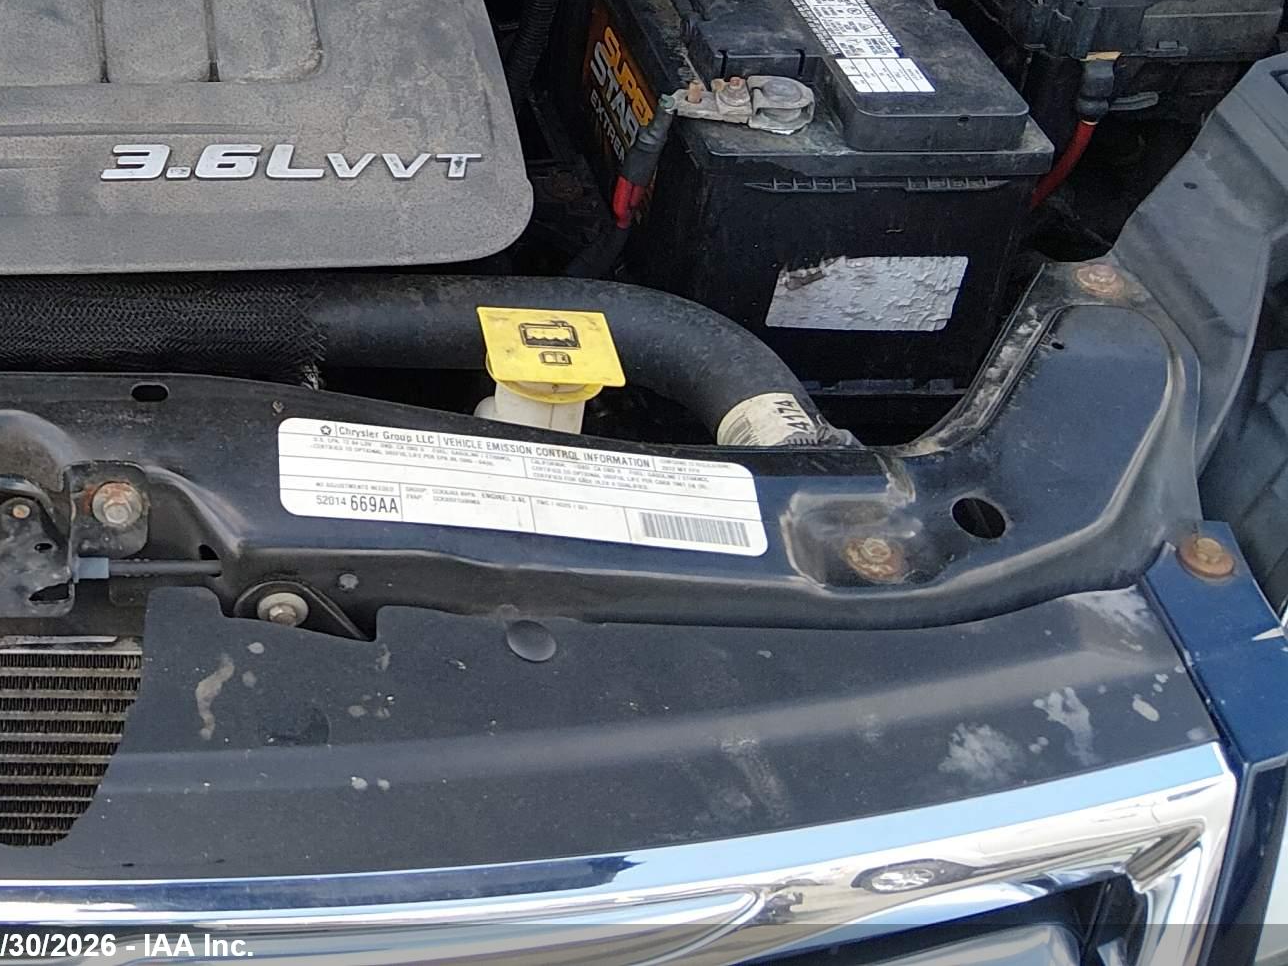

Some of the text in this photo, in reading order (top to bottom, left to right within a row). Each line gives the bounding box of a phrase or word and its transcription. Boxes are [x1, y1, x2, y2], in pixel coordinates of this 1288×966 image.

[604, 26, 655, 127] SUPER
[100, 144, 482, 181] 3.6L VVT
[774, 400, 811, 431] 4174
[338, 425, 435, 445] Chrysler Group LLC
[442, 436, 484, 451] VEHICLE
[485, 441, 533, 455] EMISSION
[535, 446, 581, 461] CONTROL
[583, 452, 651, 468] INFORMATION
[315, 494, 400, 514] 52014 669AA
